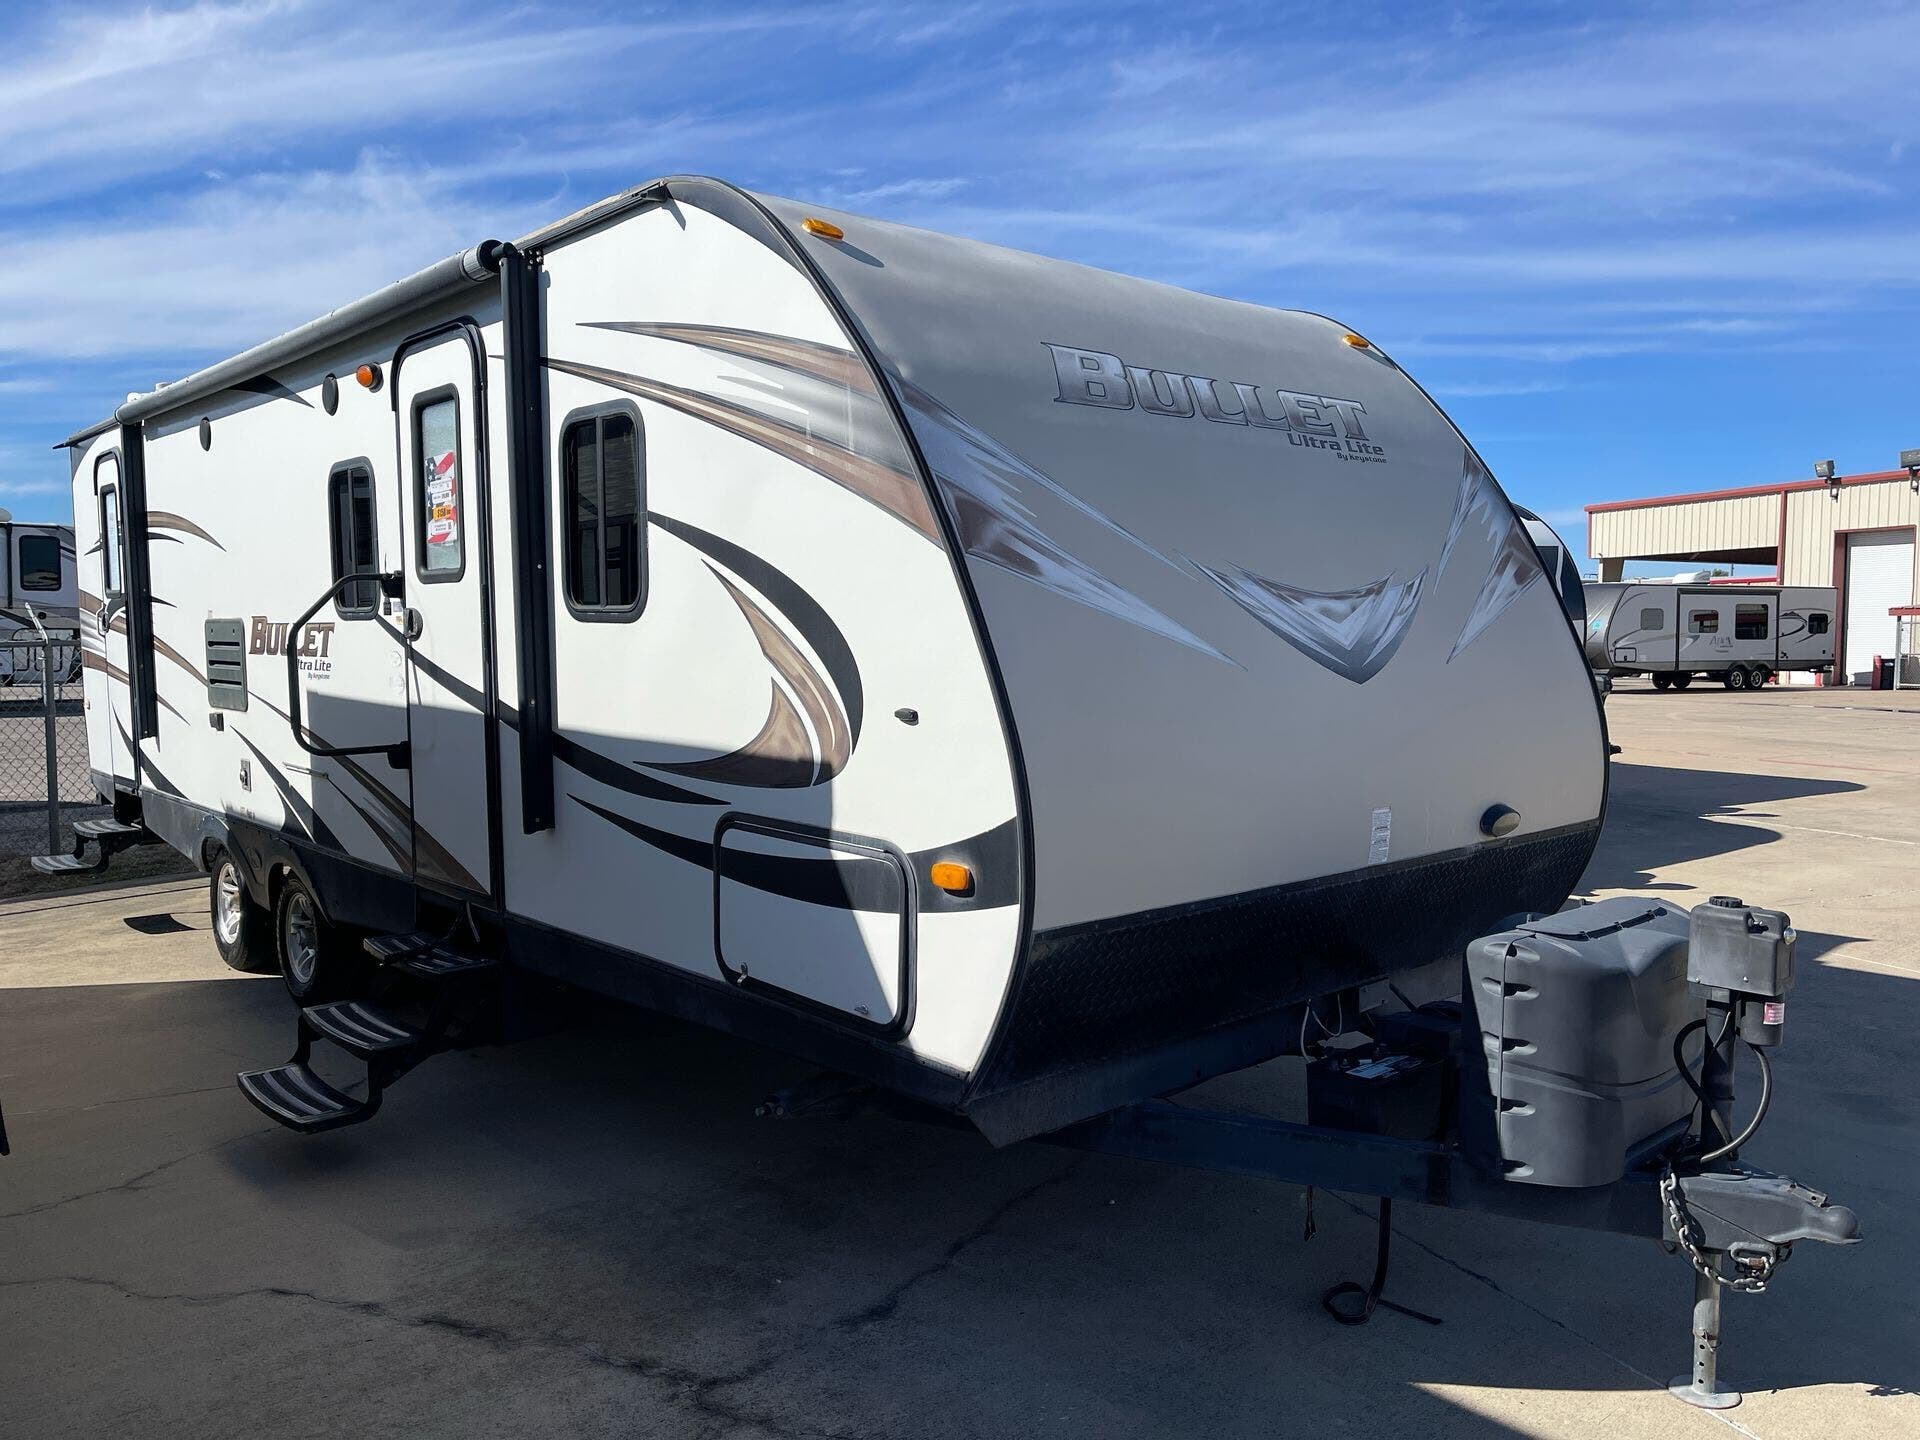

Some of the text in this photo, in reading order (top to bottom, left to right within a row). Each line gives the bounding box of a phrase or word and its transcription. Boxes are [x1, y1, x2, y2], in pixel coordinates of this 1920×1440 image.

[1287, 433, 1384, 456] Ultra Lite
[1336, 452, 1348, 461] By
[314, 659, 331, 672] Lite
